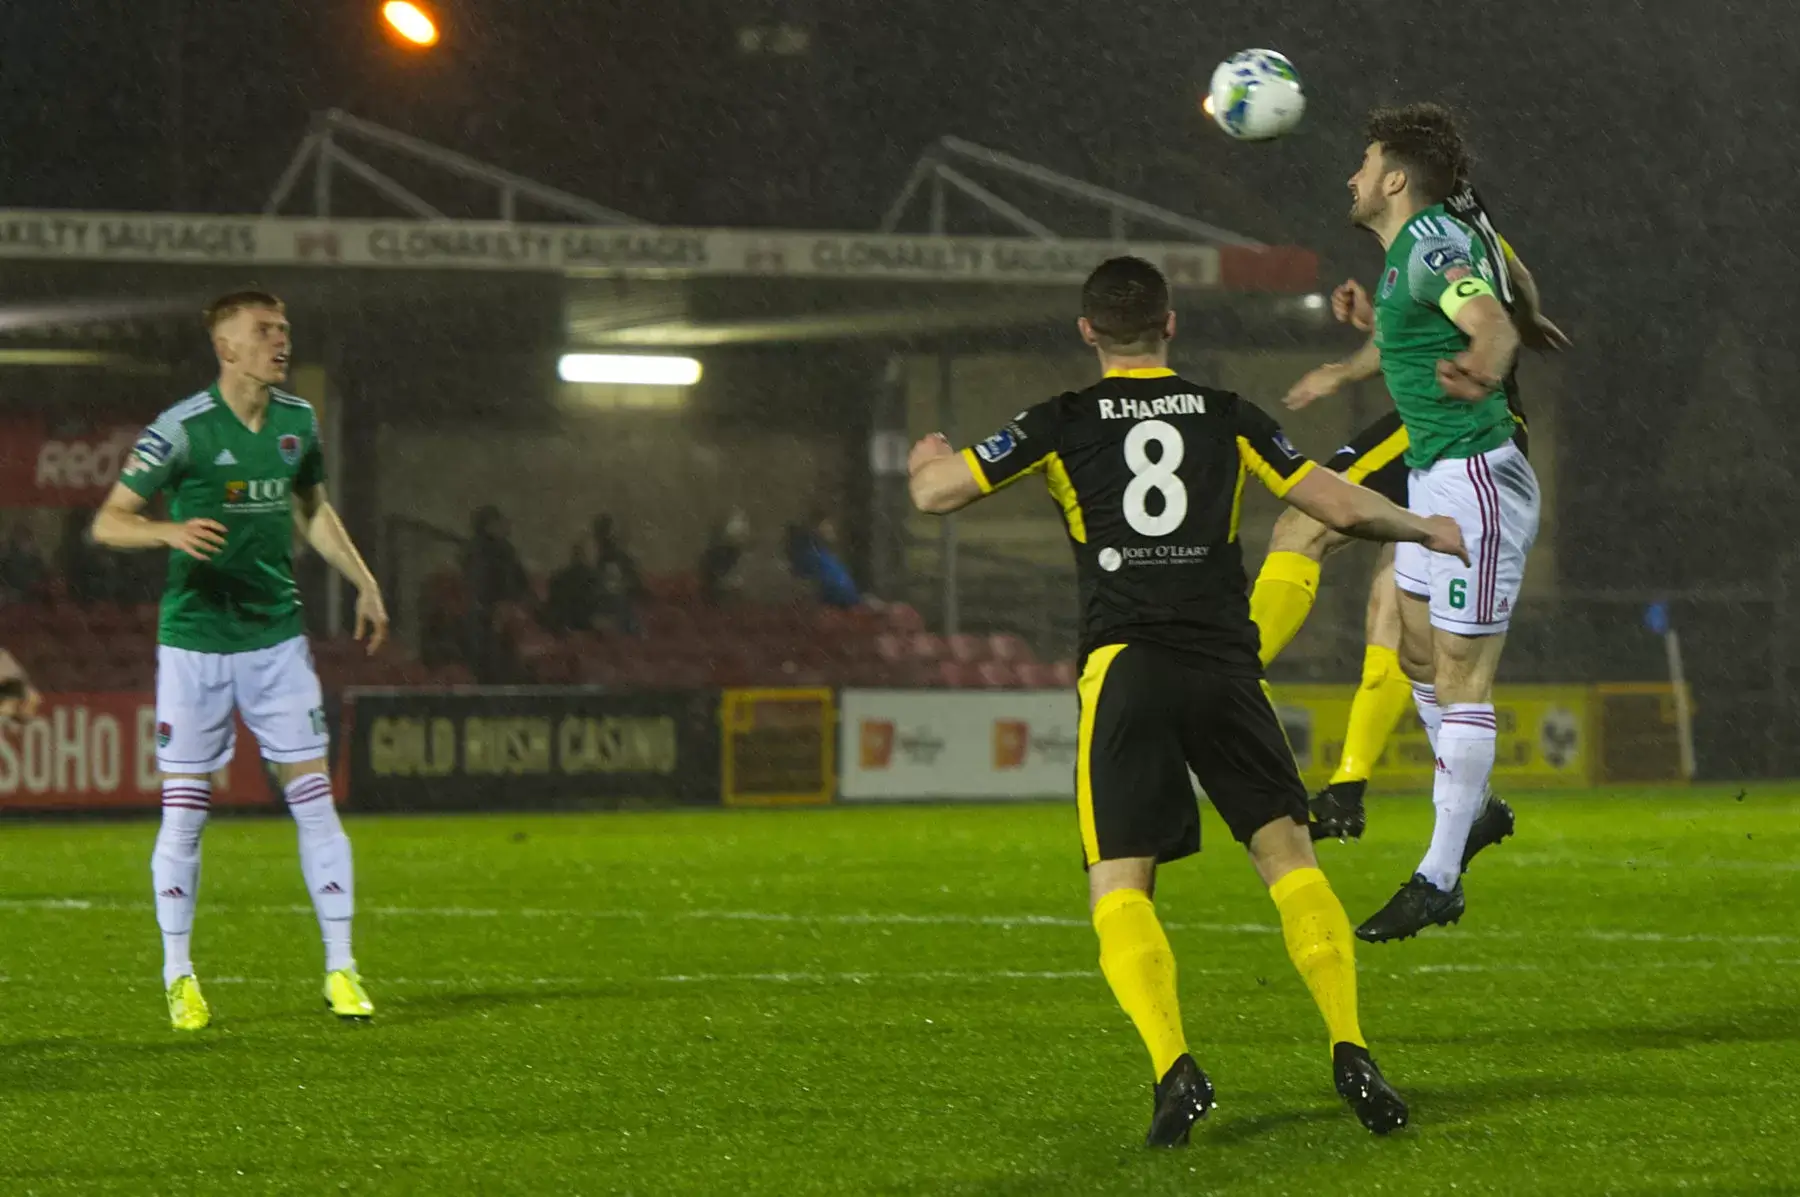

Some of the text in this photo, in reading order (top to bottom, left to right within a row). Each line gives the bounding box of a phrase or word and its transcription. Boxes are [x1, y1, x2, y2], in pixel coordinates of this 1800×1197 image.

[1456, 281, 1479, 297] C
[1098, 393, 1206, 419] R.HARKIN
[1123, 419, 1188, 537] 8
[1450, 578, 1467, 609] 6
[370, 715, 677, 777] GOLD RUSH CASINO
